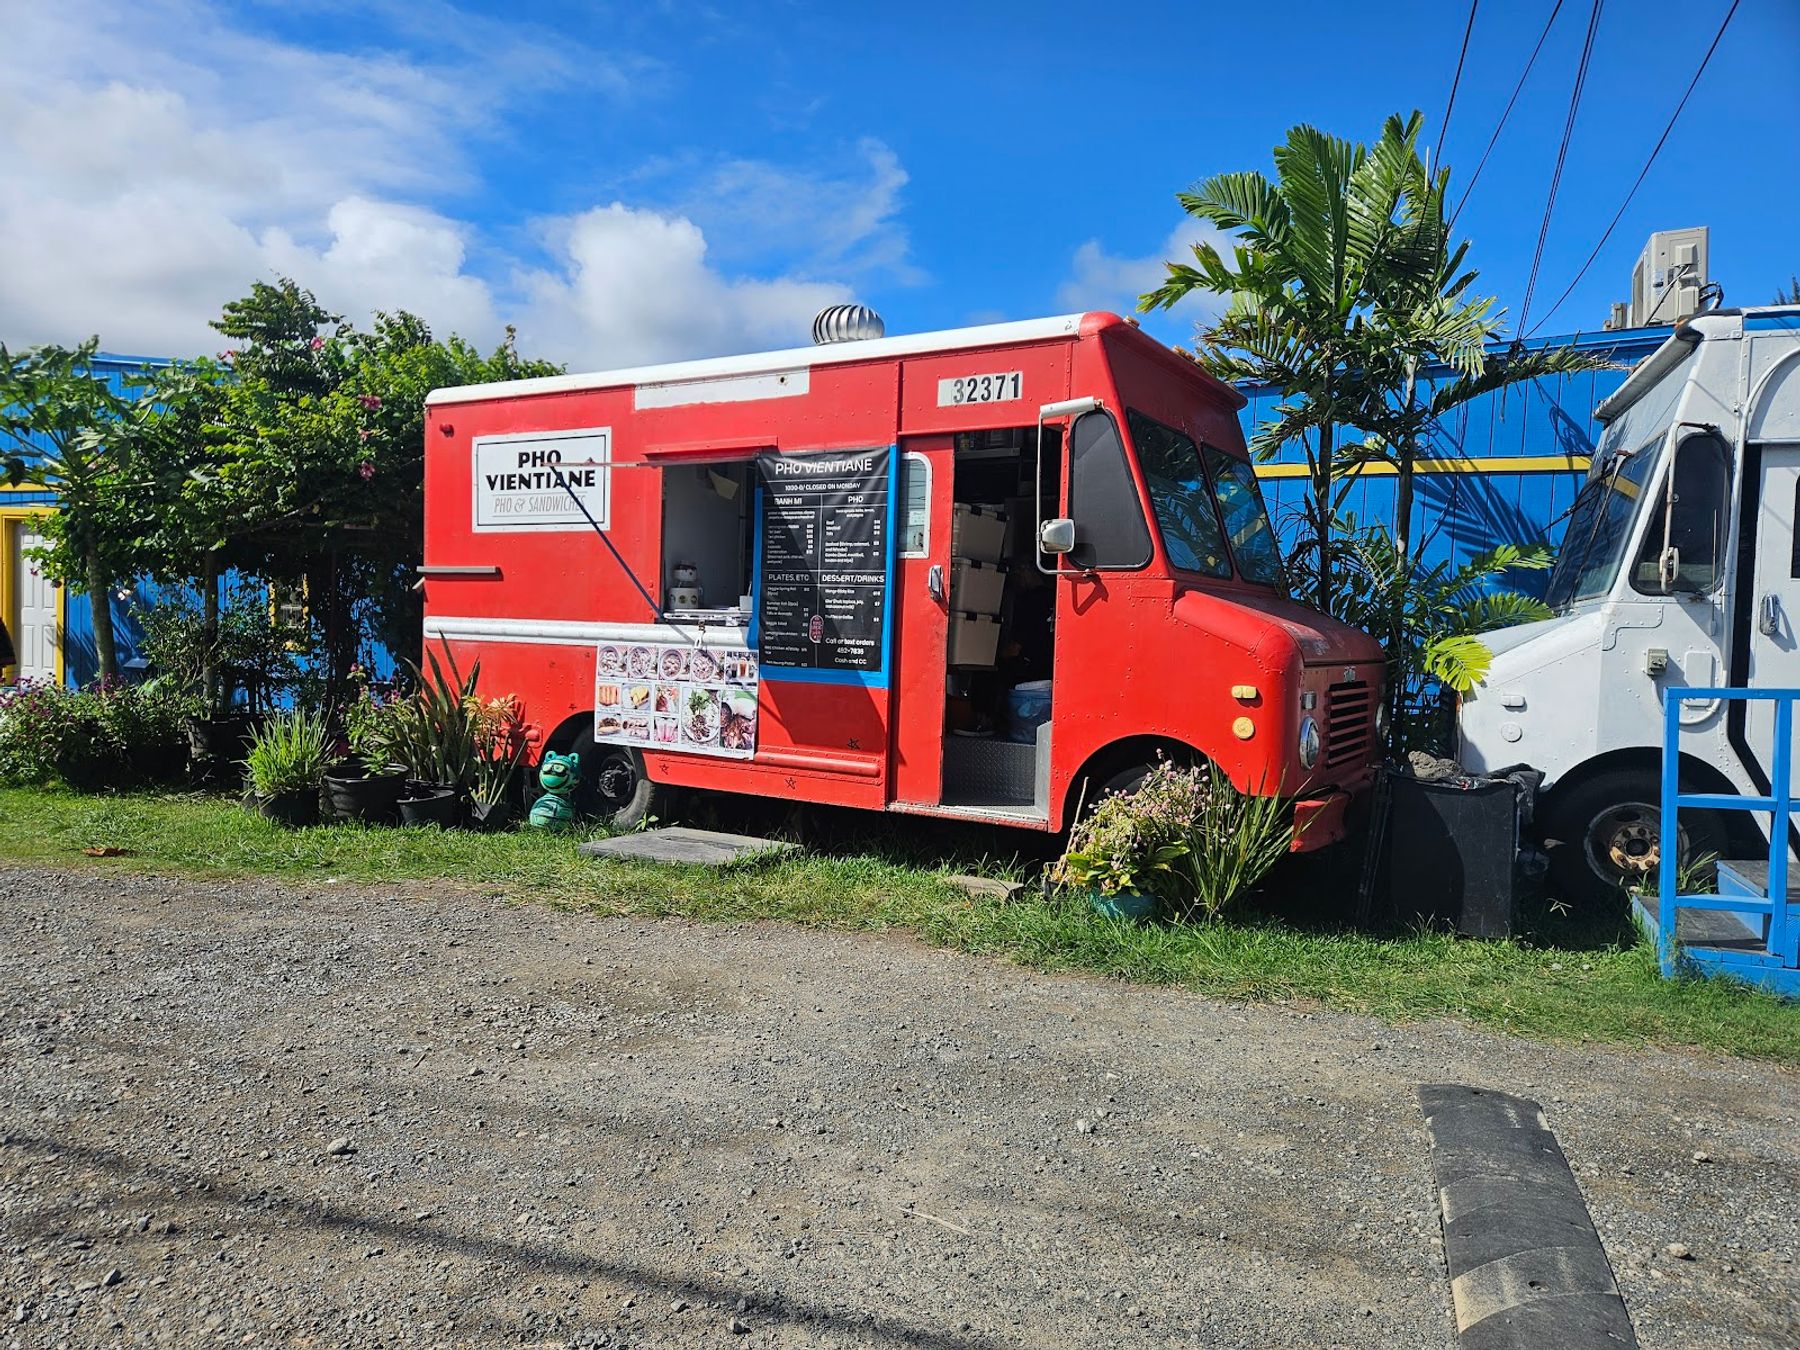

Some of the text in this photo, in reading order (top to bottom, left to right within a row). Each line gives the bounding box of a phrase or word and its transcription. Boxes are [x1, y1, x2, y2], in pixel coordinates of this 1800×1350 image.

[953, 373, 1020, 403] 32371
[518, 449, 562, 468] PHO
[775, 458, 873, 475] PHO VIENTIANE
[486, 470, 596, 491] VIENTIANE
[836, 482, 861, 490] MONDAY
[494, 497, 512, 513] PHO
[514, 498, 526, 513] &
[848, 495, 864, 504] PHO
[822, 574, 885, 583] DESSERT/DRINKS
